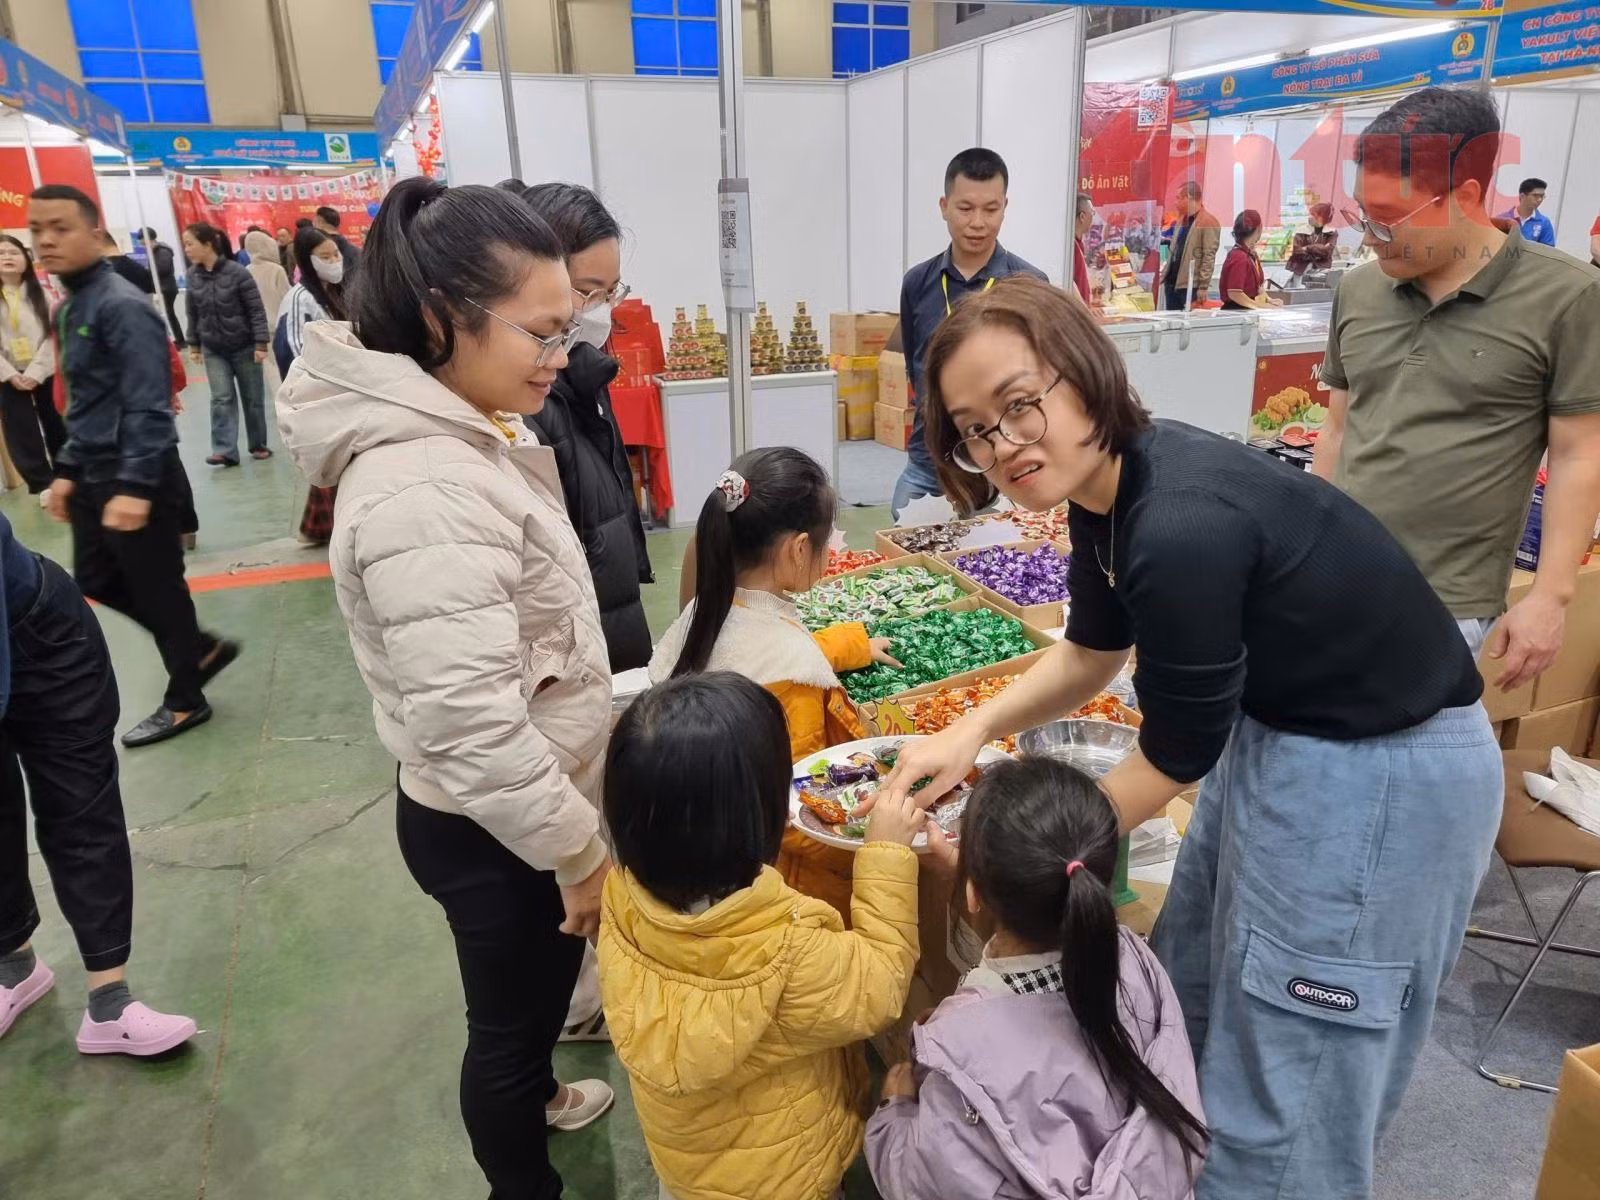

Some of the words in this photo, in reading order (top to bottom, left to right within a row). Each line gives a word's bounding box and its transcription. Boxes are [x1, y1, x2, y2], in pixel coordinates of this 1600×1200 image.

[1544, 12, 1581, 28] CÔNG
[1521, 32, 1569, 48] YAKULT
[1272, 64, 1297, 78] CÔNG
[1299, 63, 1310, 73] TY
[1283, 80, 1309, 95] NÔNG
[1335, 74, 1349, 86] BA
[1082, 173, 1094, 190] Đồ
[1112, 174, 1129, 191] Vặt
[1294, 984, 1351, 1008] OUTDOOR
